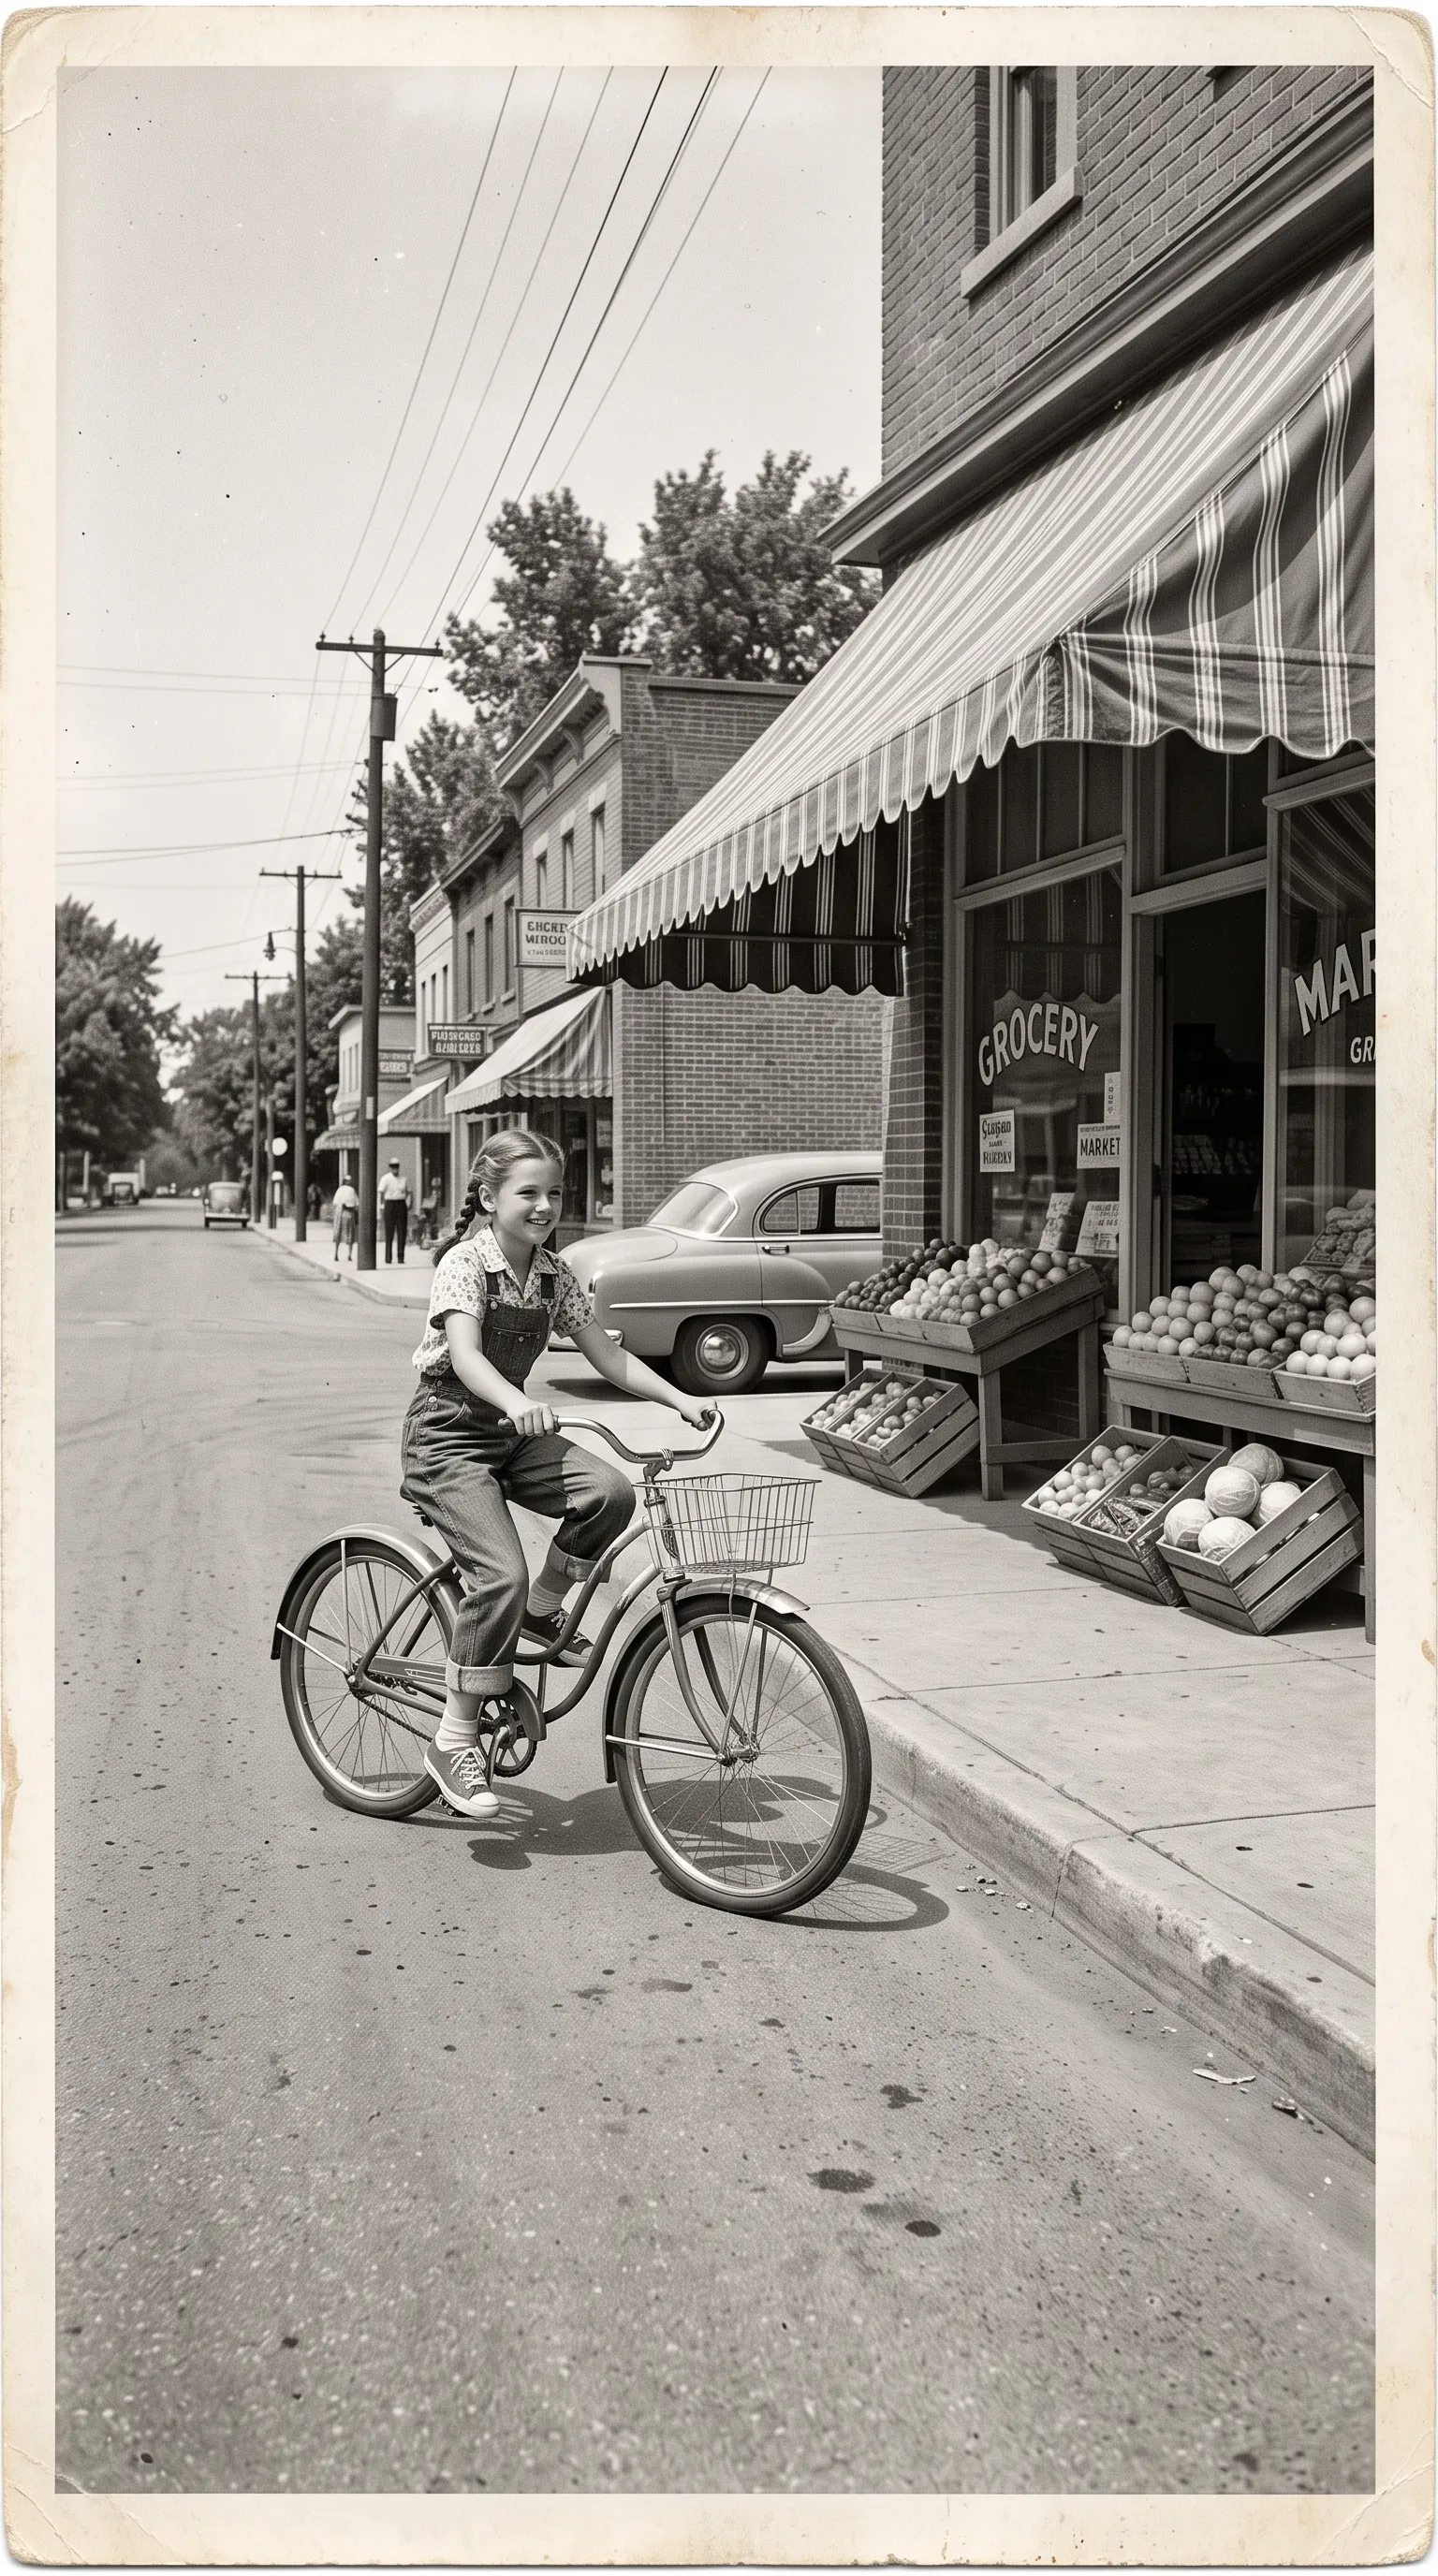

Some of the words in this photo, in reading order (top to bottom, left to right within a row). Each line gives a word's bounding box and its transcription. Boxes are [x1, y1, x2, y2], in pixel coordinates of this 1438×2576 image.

[978, 1003, 1099, 1086] GROCERY
[1350, 1036, 1376, 1063] GR
[1080, 1137, 1121, 1156] MARKET
